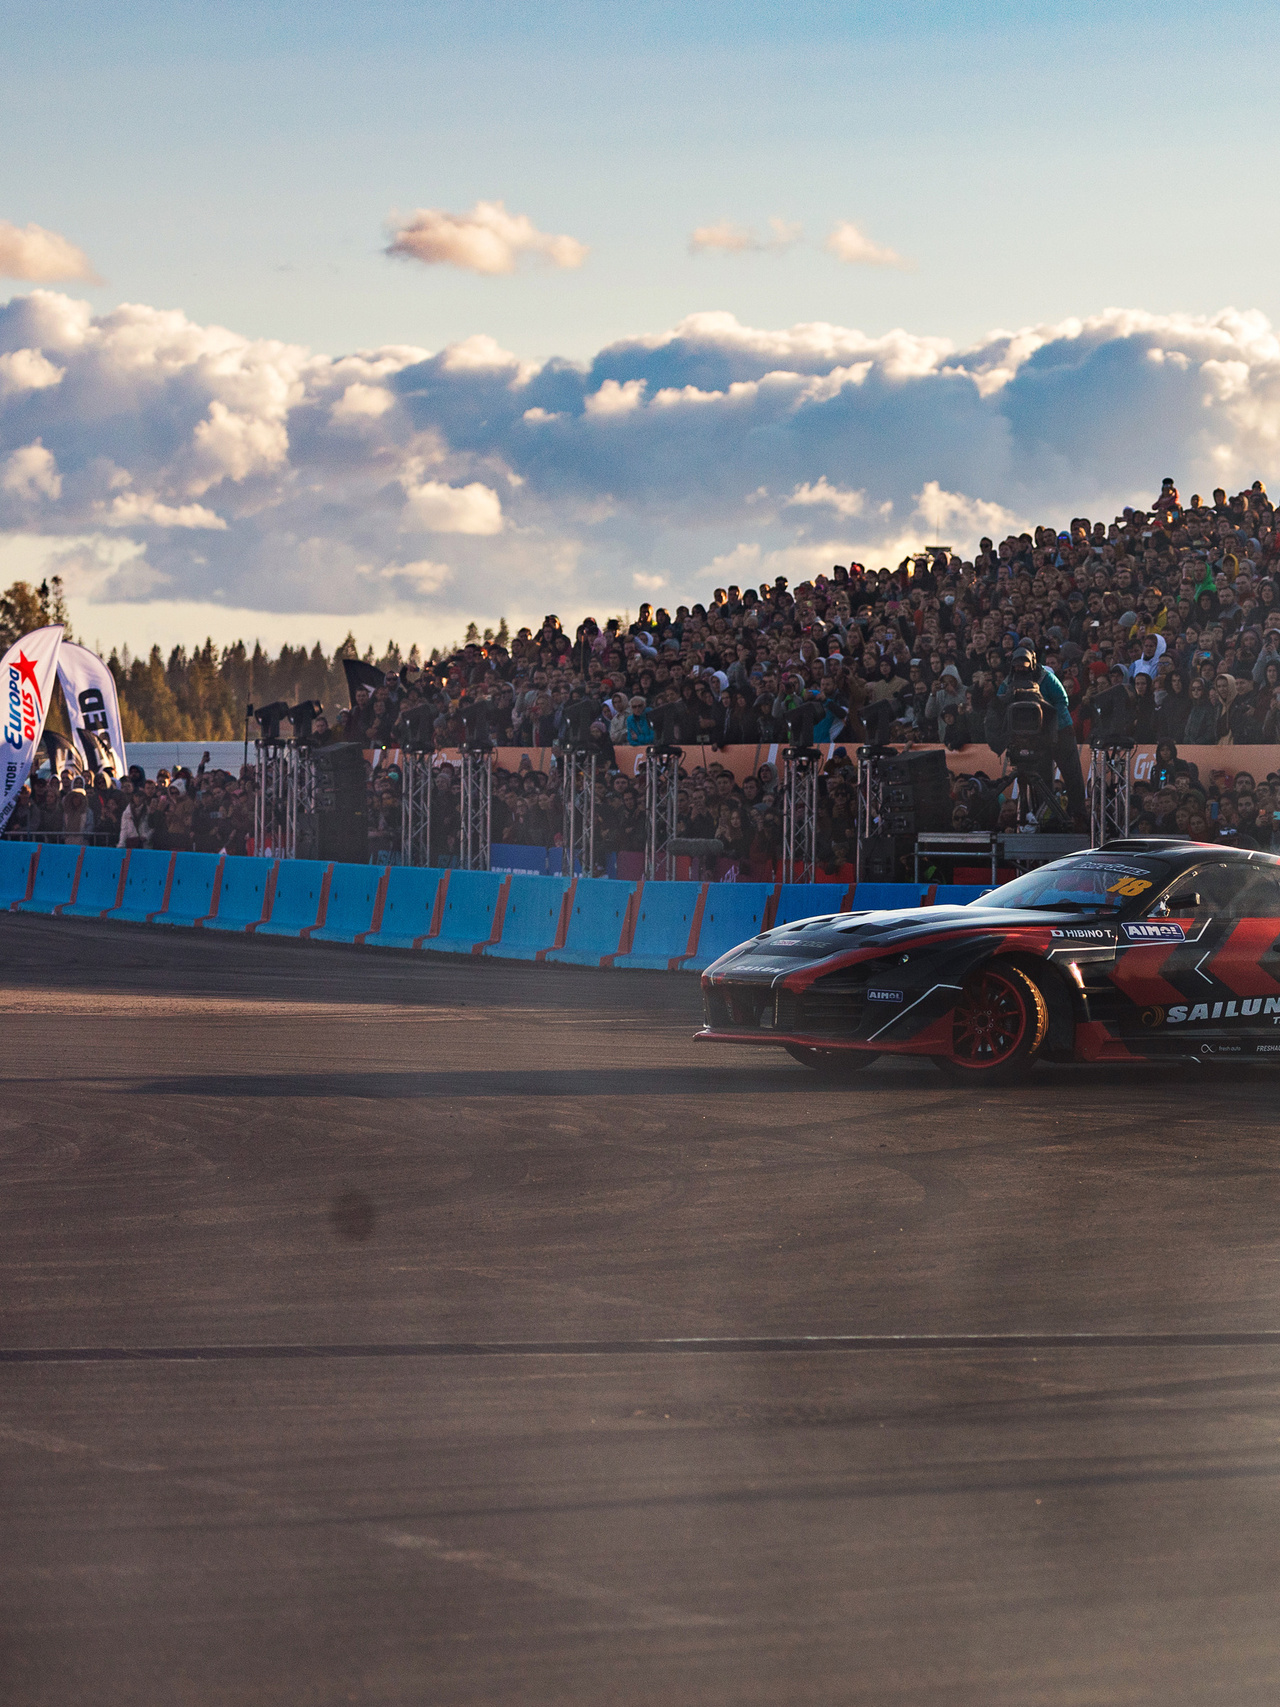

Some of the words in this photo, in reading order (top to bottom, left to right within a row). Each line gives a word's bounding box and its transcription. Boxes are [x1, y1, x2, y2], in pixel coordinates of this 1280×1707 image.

[1106, 877, 1153, 896] 18
[1066, 930, 1103, 938] HIBINO
[1104, 930, 1115, 938] T.
[1128, 925, 1182, 936] AIMOL
[869, 991, 900, 1000] AIMOL
